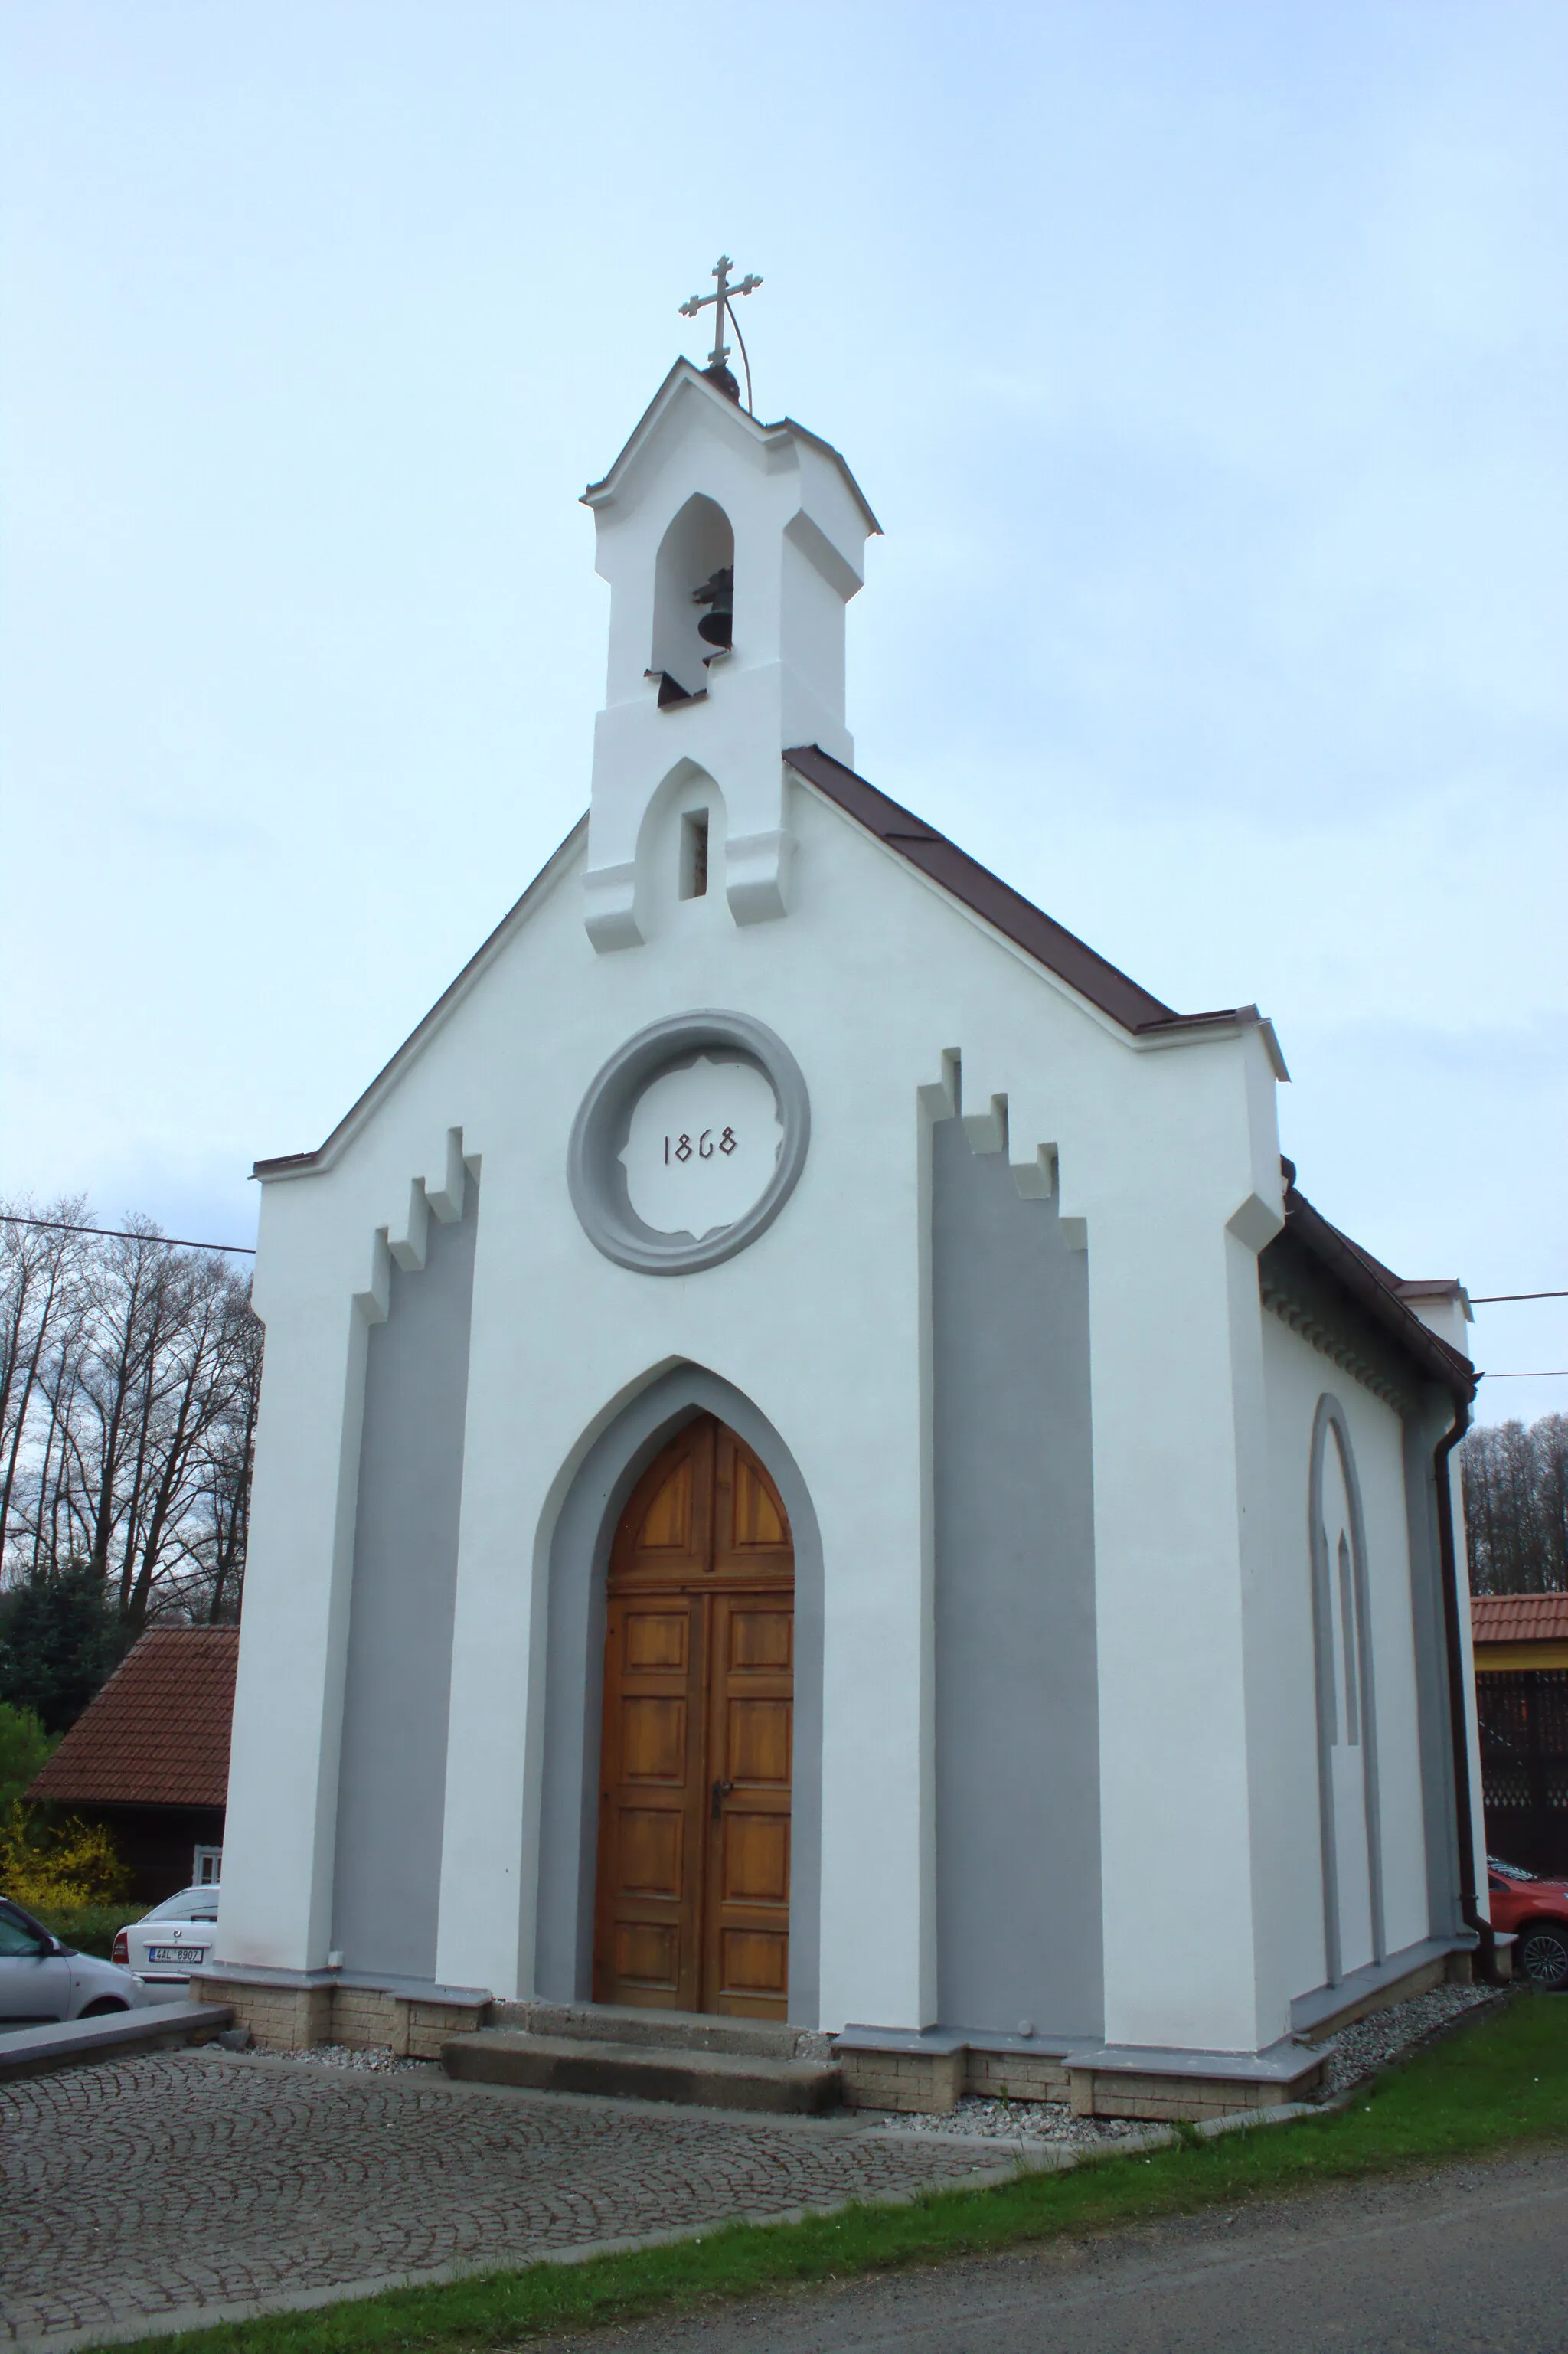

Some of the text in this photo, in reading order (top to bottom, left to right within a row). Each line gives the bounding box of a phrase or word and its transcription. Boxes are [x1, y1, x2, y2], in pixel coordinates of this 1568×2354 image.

[664, 1126, 738, 1166] 1868
[157, 1950, 199, 1960] 4AL 8907
